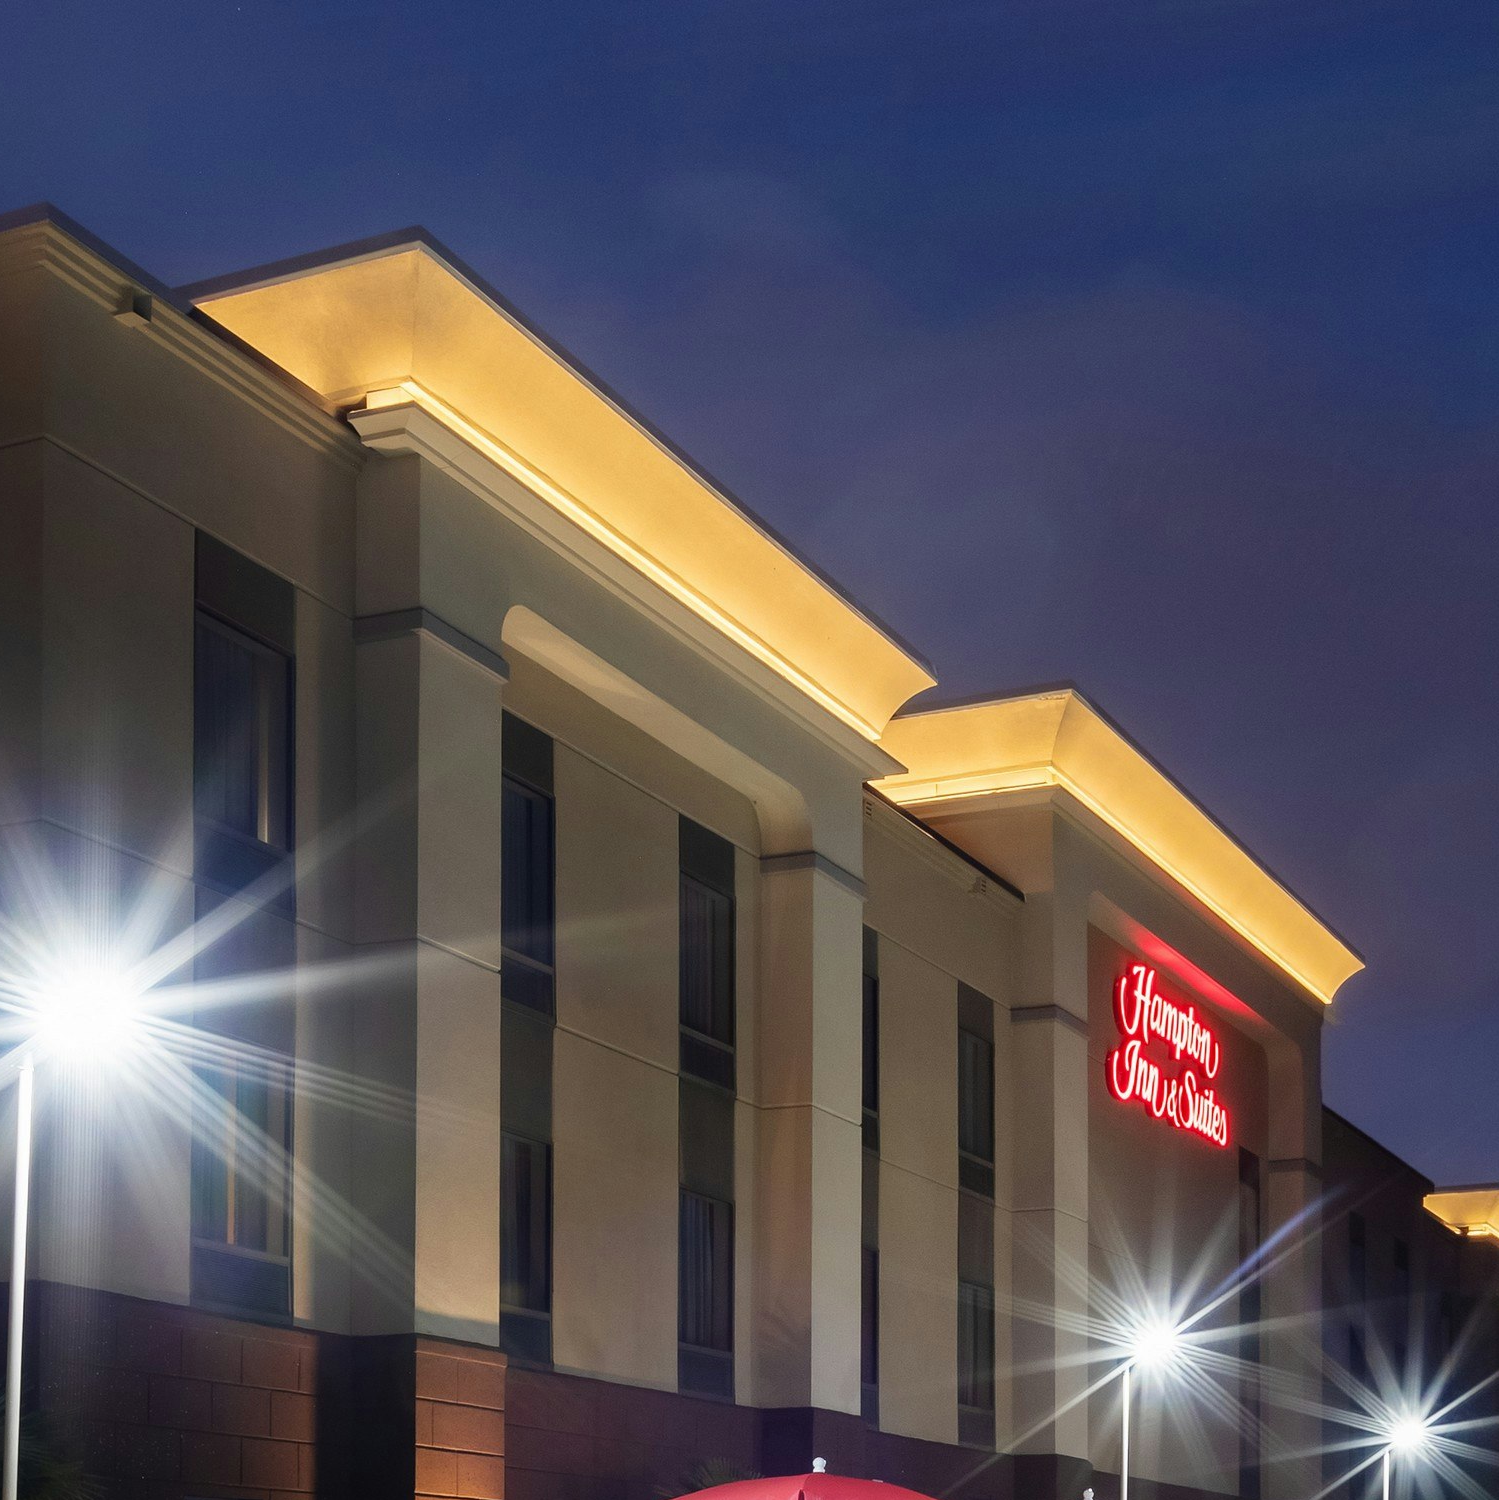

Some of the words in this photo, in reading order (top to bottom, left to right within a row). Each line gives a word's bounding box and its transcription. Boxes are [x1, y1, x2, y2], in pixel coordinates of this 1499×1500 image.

[1120, 965, 1219, 1079] Hampton
[1113, 1039, 1168, 1117] Inn
[1178, 1070, 1227, 1146] Suites
